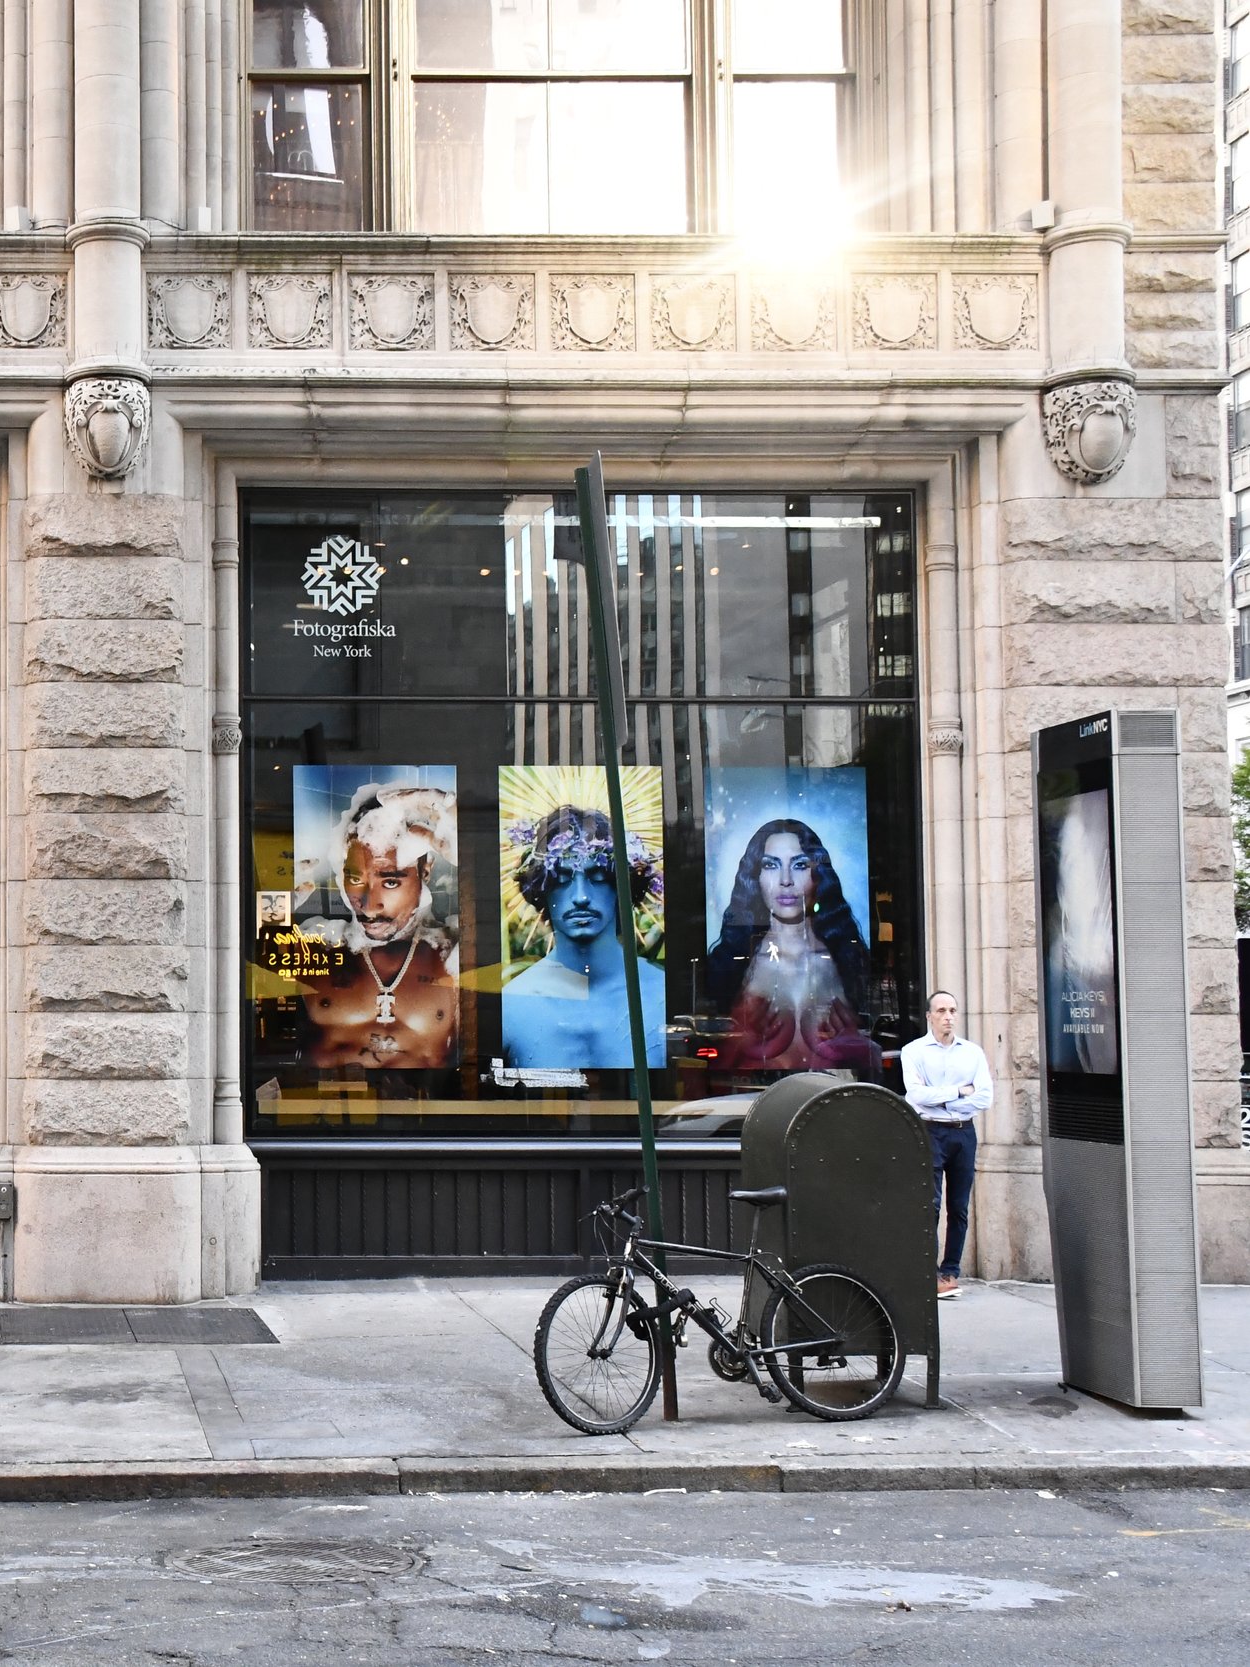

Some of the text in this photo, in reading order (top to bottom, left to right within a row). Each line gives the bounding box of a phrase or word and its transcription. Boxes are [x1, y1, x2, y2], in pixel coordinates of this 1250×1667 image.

[293, 618, 396, 642] Fotografiska
[313, 645, 372, 657] New York
[1070, 1007, 1090, 1018] KEYS
[1091, 1023, 1105, 1034] NOW
